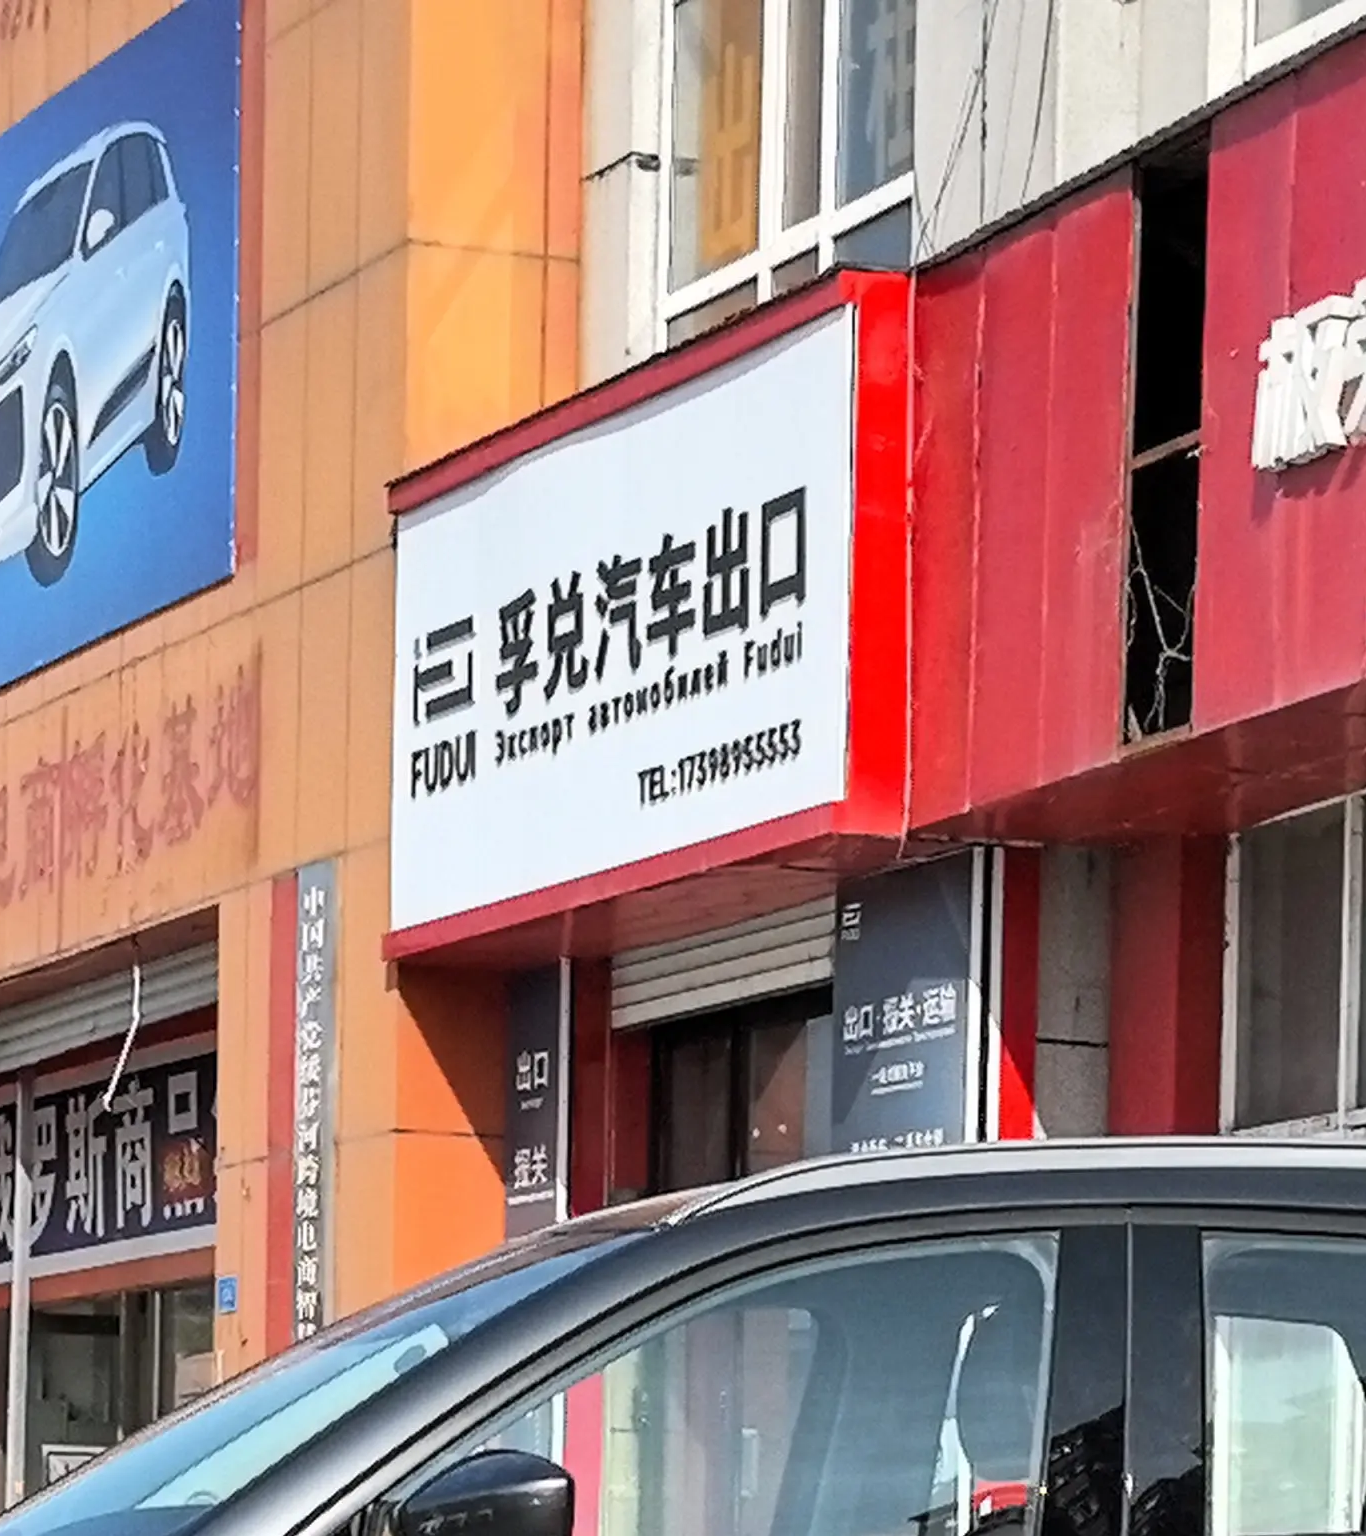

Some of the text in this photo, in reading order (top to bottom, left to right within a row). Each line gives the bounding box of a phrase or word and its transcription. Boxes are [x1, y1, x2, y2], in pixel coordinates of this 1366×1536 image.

[495, 486, 806, 719] 孚兑汽车出口
[495, 621, 803, 766] Экспорт автомобилей Fudui
[410, 729, 477, 799] FUDUI
[516, 1050, 549, 1091] 出口
